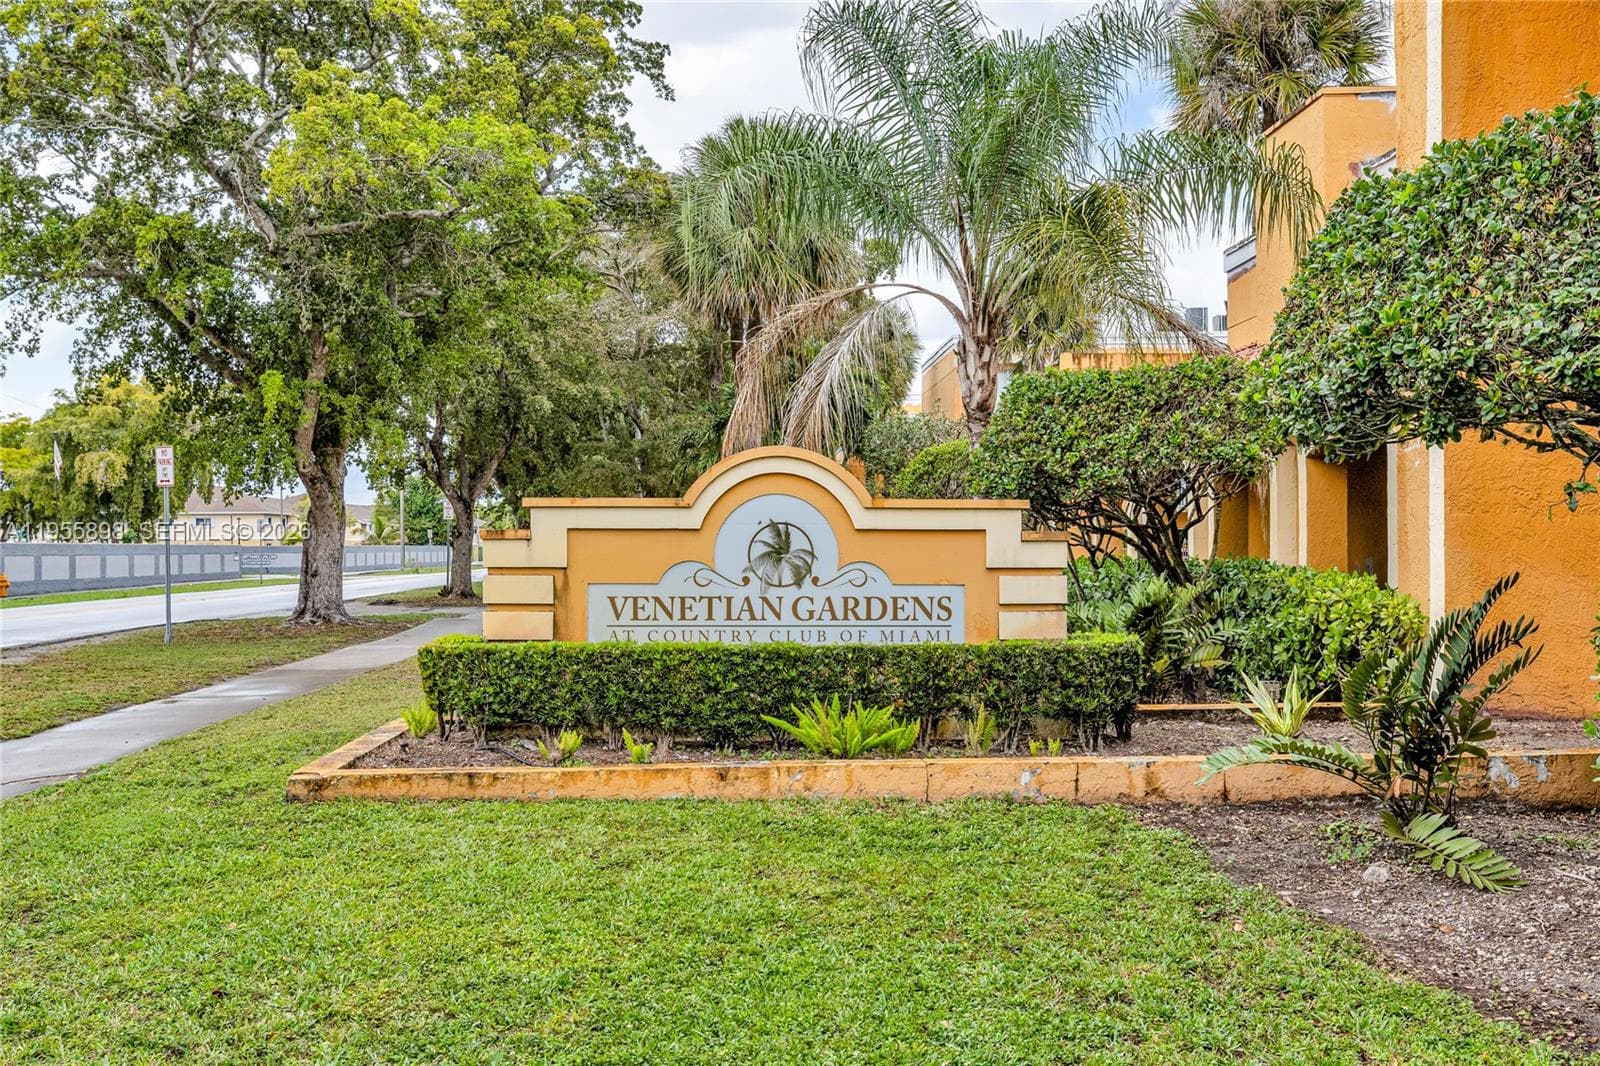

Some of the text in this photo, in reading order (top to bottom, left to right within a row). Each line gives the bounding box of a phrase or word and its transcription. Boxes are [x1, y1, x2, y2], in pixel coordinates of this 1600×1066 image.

[606, 595, 953, 622] VENETIAN GARDENS
[609, 629, 952, 643] AT COUNTRY CLUB OF MIAMI
